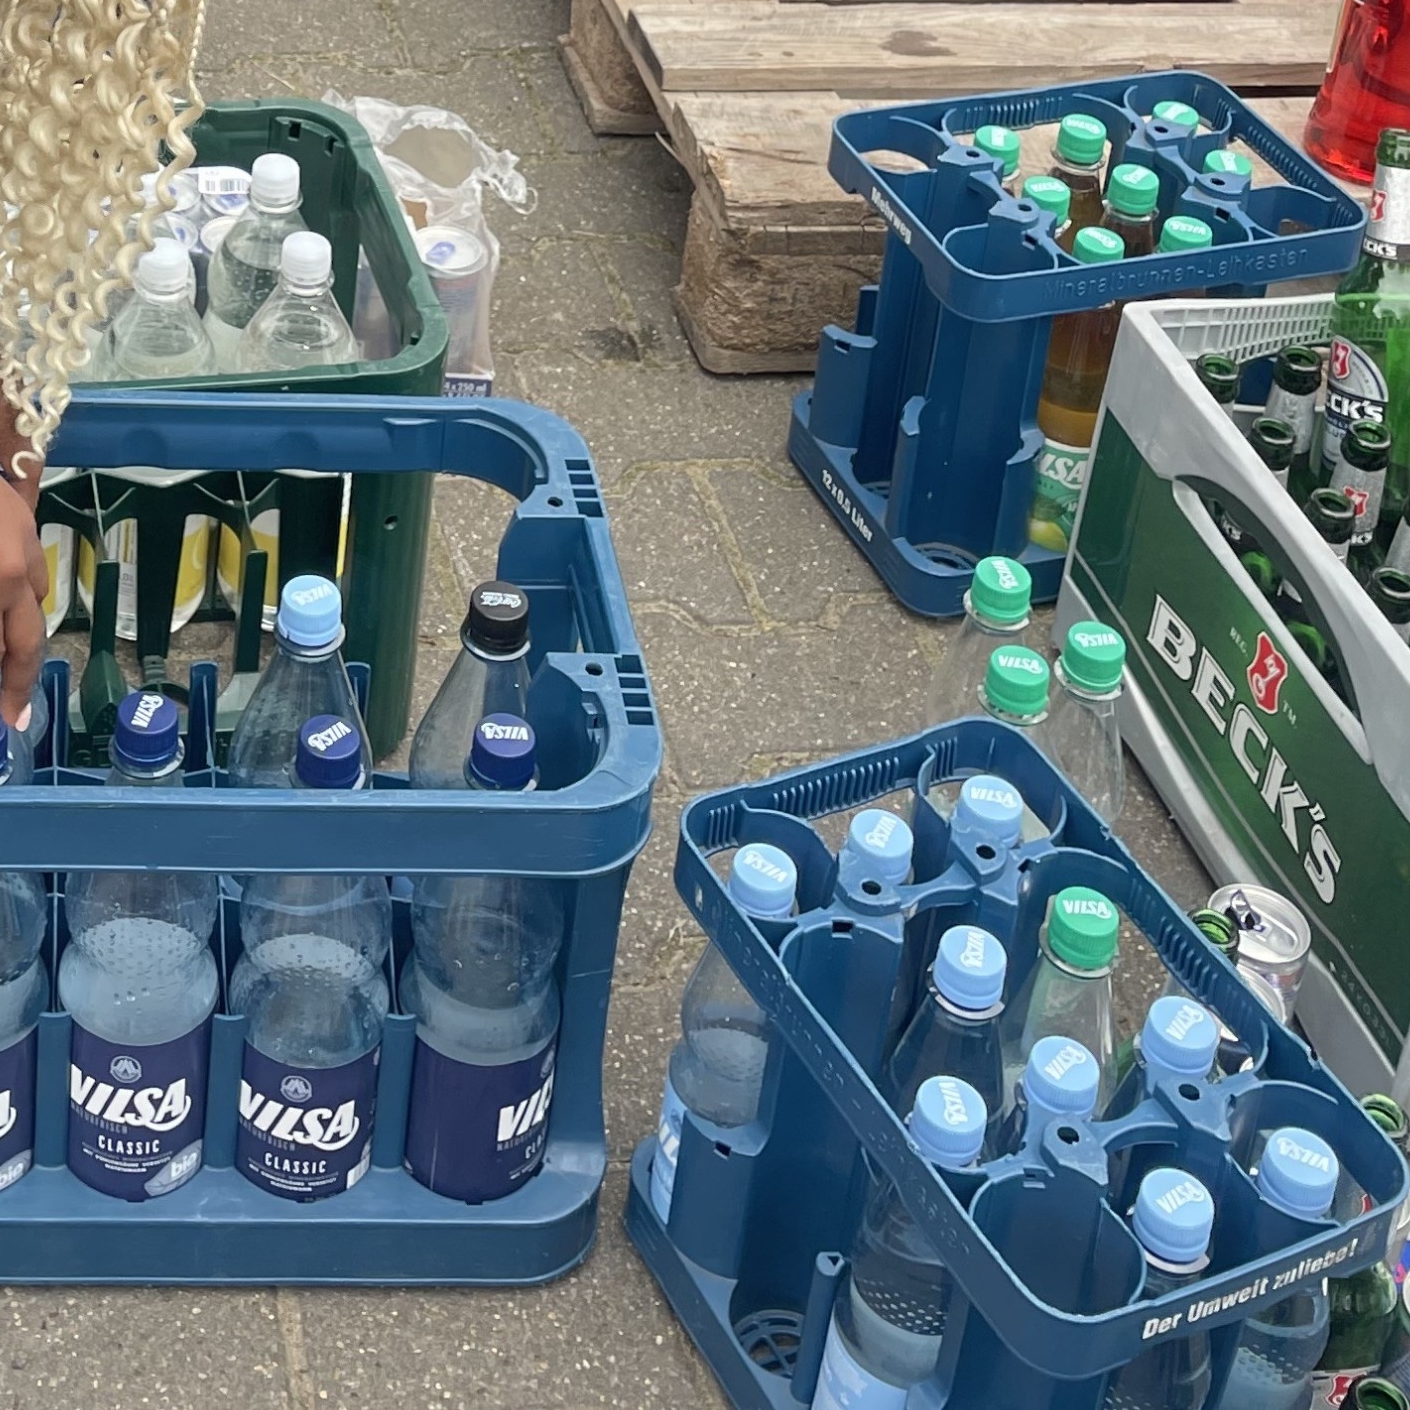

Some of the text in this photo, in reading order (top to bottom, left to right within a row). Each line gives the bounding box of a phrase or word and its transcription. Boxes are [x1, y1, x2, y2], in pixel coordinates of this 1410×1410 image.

[870, 186, 912, 245] Mehrweg
[1328, 392, 1384, 424] CK'S
[1039, 453, 1089, 490] LSA
[822, 469, 833, 491] 12
[851, 506, 873, 542] Liter
[290, 583, 333, 606] VILSA
[1075, 631, 1120, 648] VILSA
[998, 654, 1043, 674] VILSA
[131, 693, 165, 728] VILSA
[307, 721, 352, 752] VILSA
[480, 722, 529, 741] VILSA
[1146, 593, 1343, 904] BECK'S
[970, 786, 1017, 807] VILSA
[865, 815, 898, 848] VILSA
[743, 850, 788, 883] VILSA
[1062, 899, 1113, 920] VILSA
[960, 930, 986, 969] VILSA
[1166, 1005, 1204, 1041] VILSA
[1044, 1045, 1087, 1081] VILSA
[70, 1063, 192, 1132] VILSA
[497, 1068, 555, 1142] VIL
[938, 1080, 969, 1127] VILSA
[239, 1078, 360, 1152] VILSA
[98, 1134, 160, 1155] CLASSIC
[1277, 1137, 1331, 1173] VILSA
[171, 1152, 197, 1178] bio
[264, 1152, 327, 1175] CLASSIC
[1155, 1181, 1206, 1215] VILSA
[1142, 1311, 1183, 1341] Der
[1273, 1237, 1359, 1290] zuliebe!
